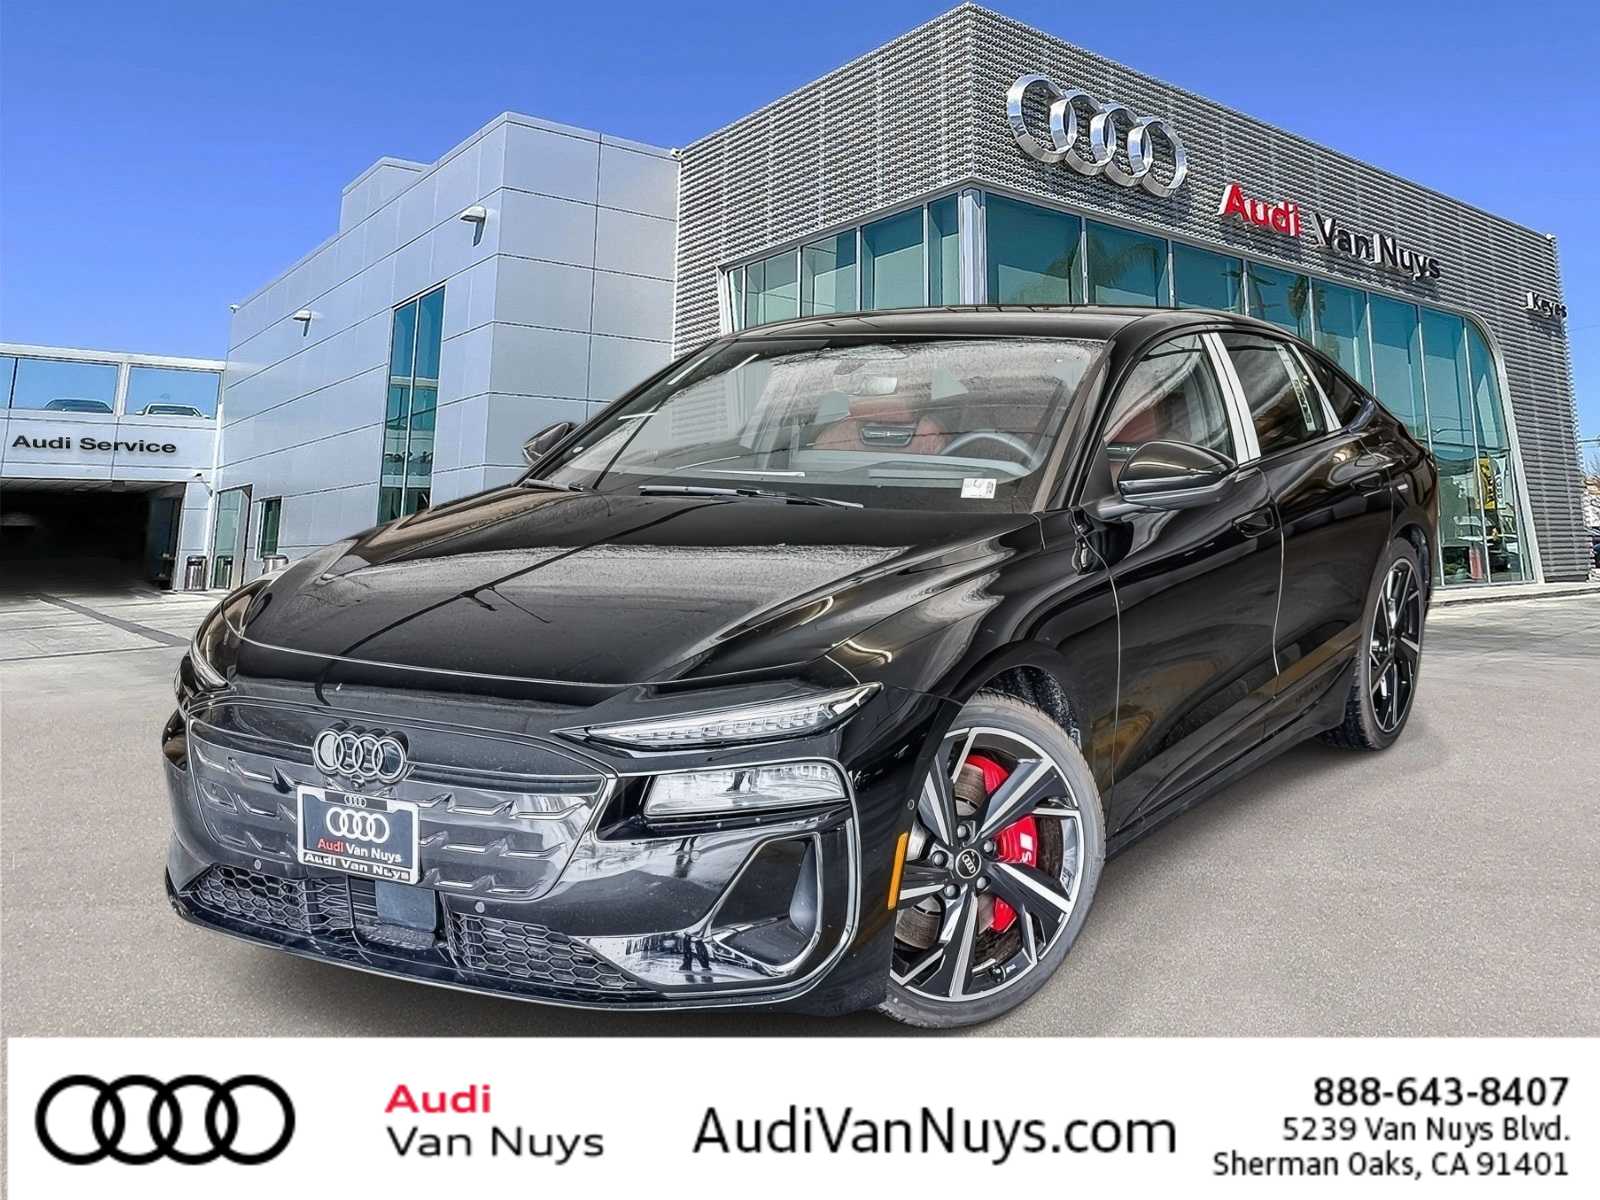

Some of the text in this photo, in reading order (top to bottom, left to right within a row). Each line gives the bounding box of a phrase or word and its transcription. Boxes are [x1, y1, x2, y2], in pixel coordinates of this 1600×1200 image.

[1217, 183, 1441, 280] Audi Van Nuys
[12, 435, 177, 453] Audi Service
[317, 838, 403, 864] Audi Van Nuys
[304, 853, 410, 880] Audi Van Nuys
